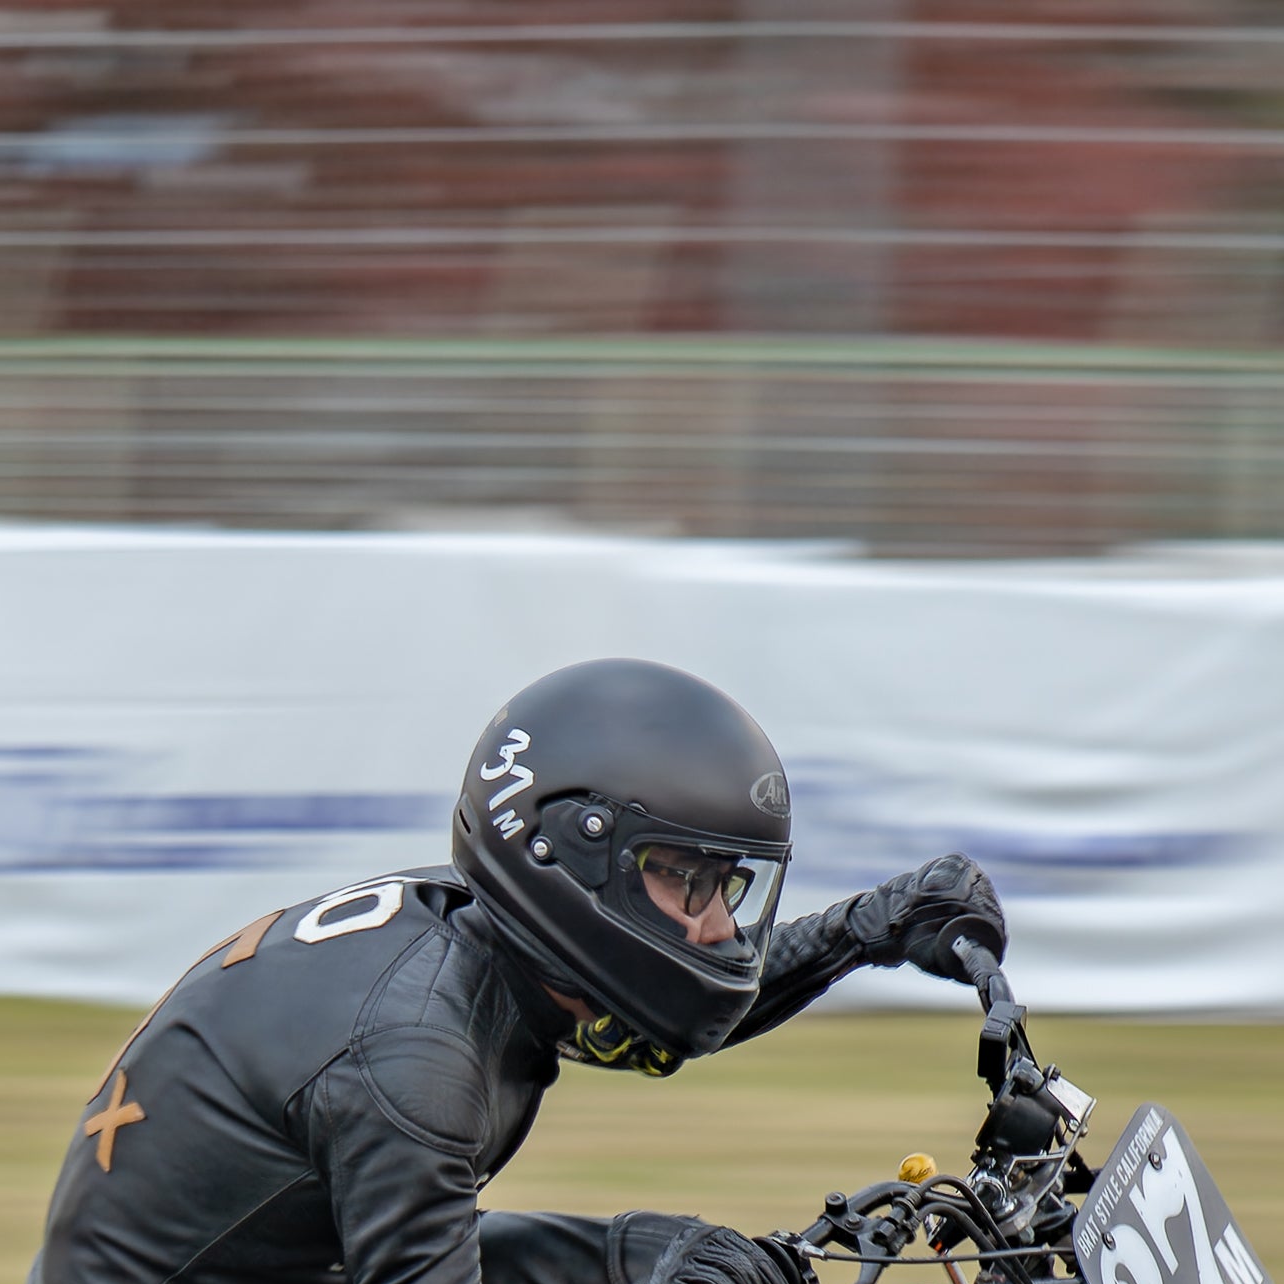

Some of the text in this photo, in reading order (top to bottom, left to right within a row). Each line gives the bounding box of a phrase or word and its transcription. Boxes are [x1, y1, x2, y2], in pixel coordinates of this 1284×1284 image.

[1077, 1106, 1164, 1260] BRAT STYLE CALIFORNIA
